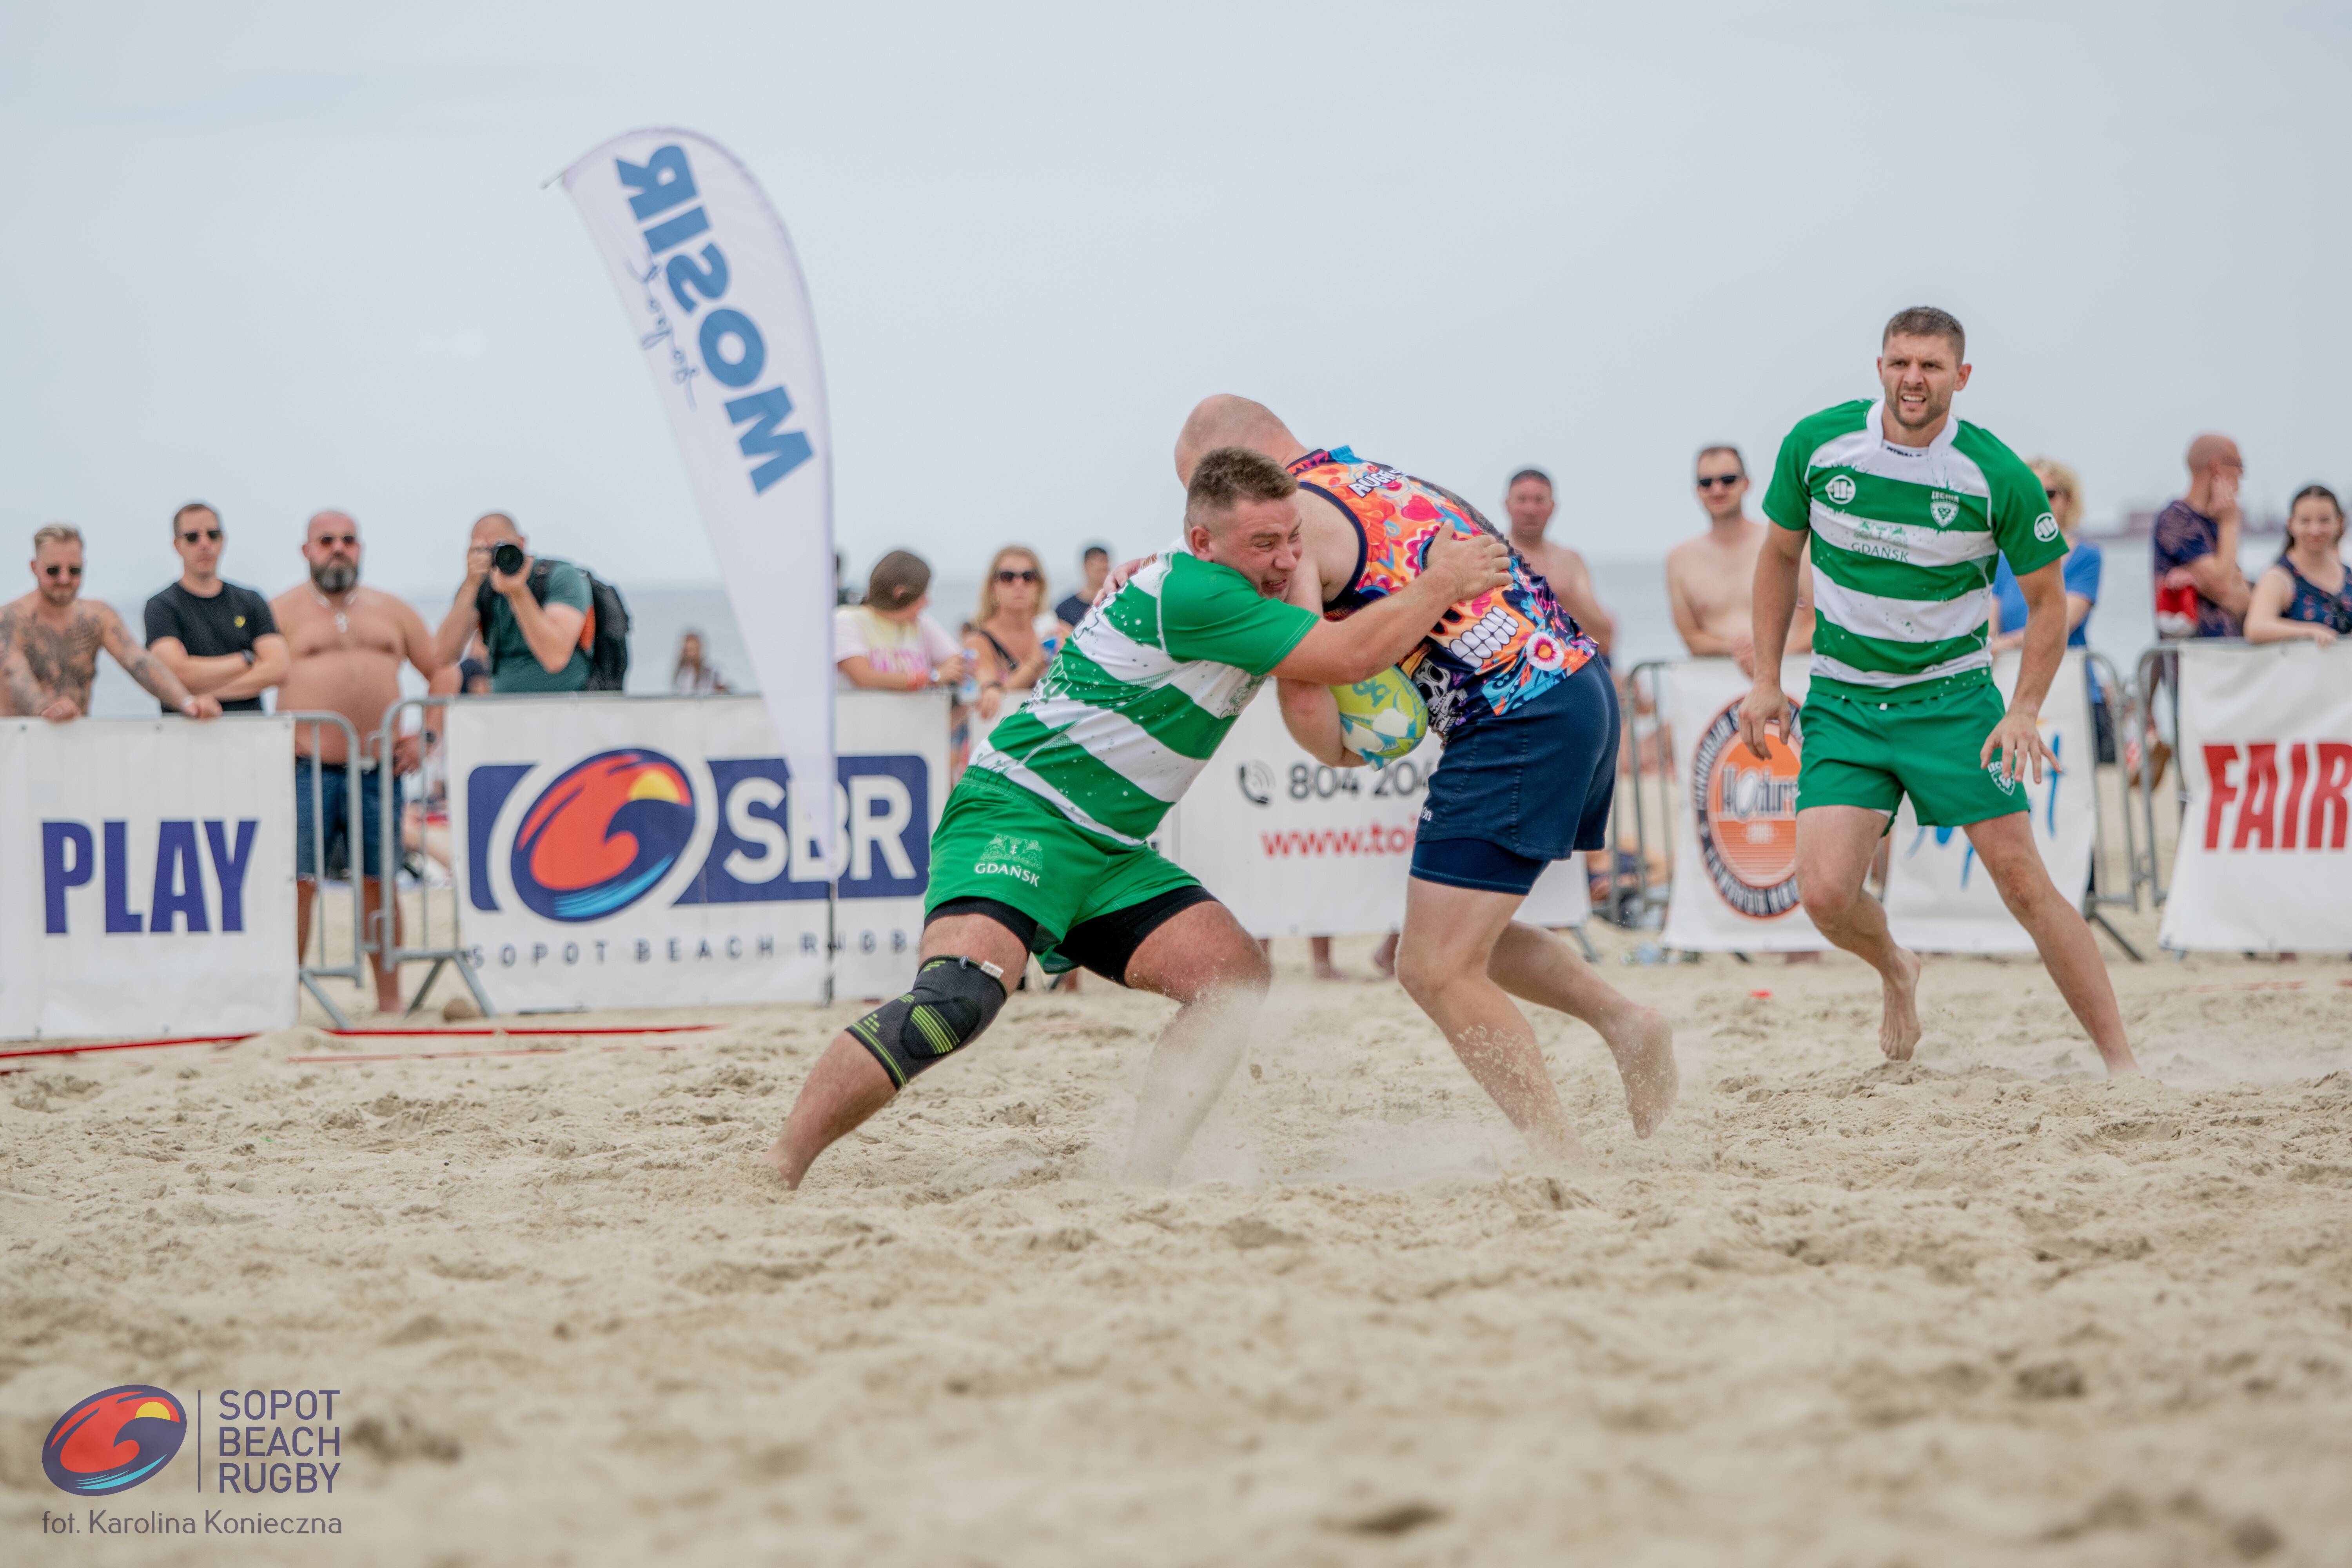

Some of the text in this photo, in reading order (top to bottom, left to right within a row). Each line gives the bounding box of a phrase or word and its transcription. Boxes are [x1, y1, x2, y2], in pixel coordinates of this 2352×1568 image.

[1290, 765, 1359, 800] 804
[2203, 743, 2352, 849] FAIR
[723, 775, 916, 885] SBR
[42, 820, 260, 933] PLAY
[975, 863, 1040, 887] GDAŃSK
[471, 929, 906, 968] SOPOT BEACH RUGB
